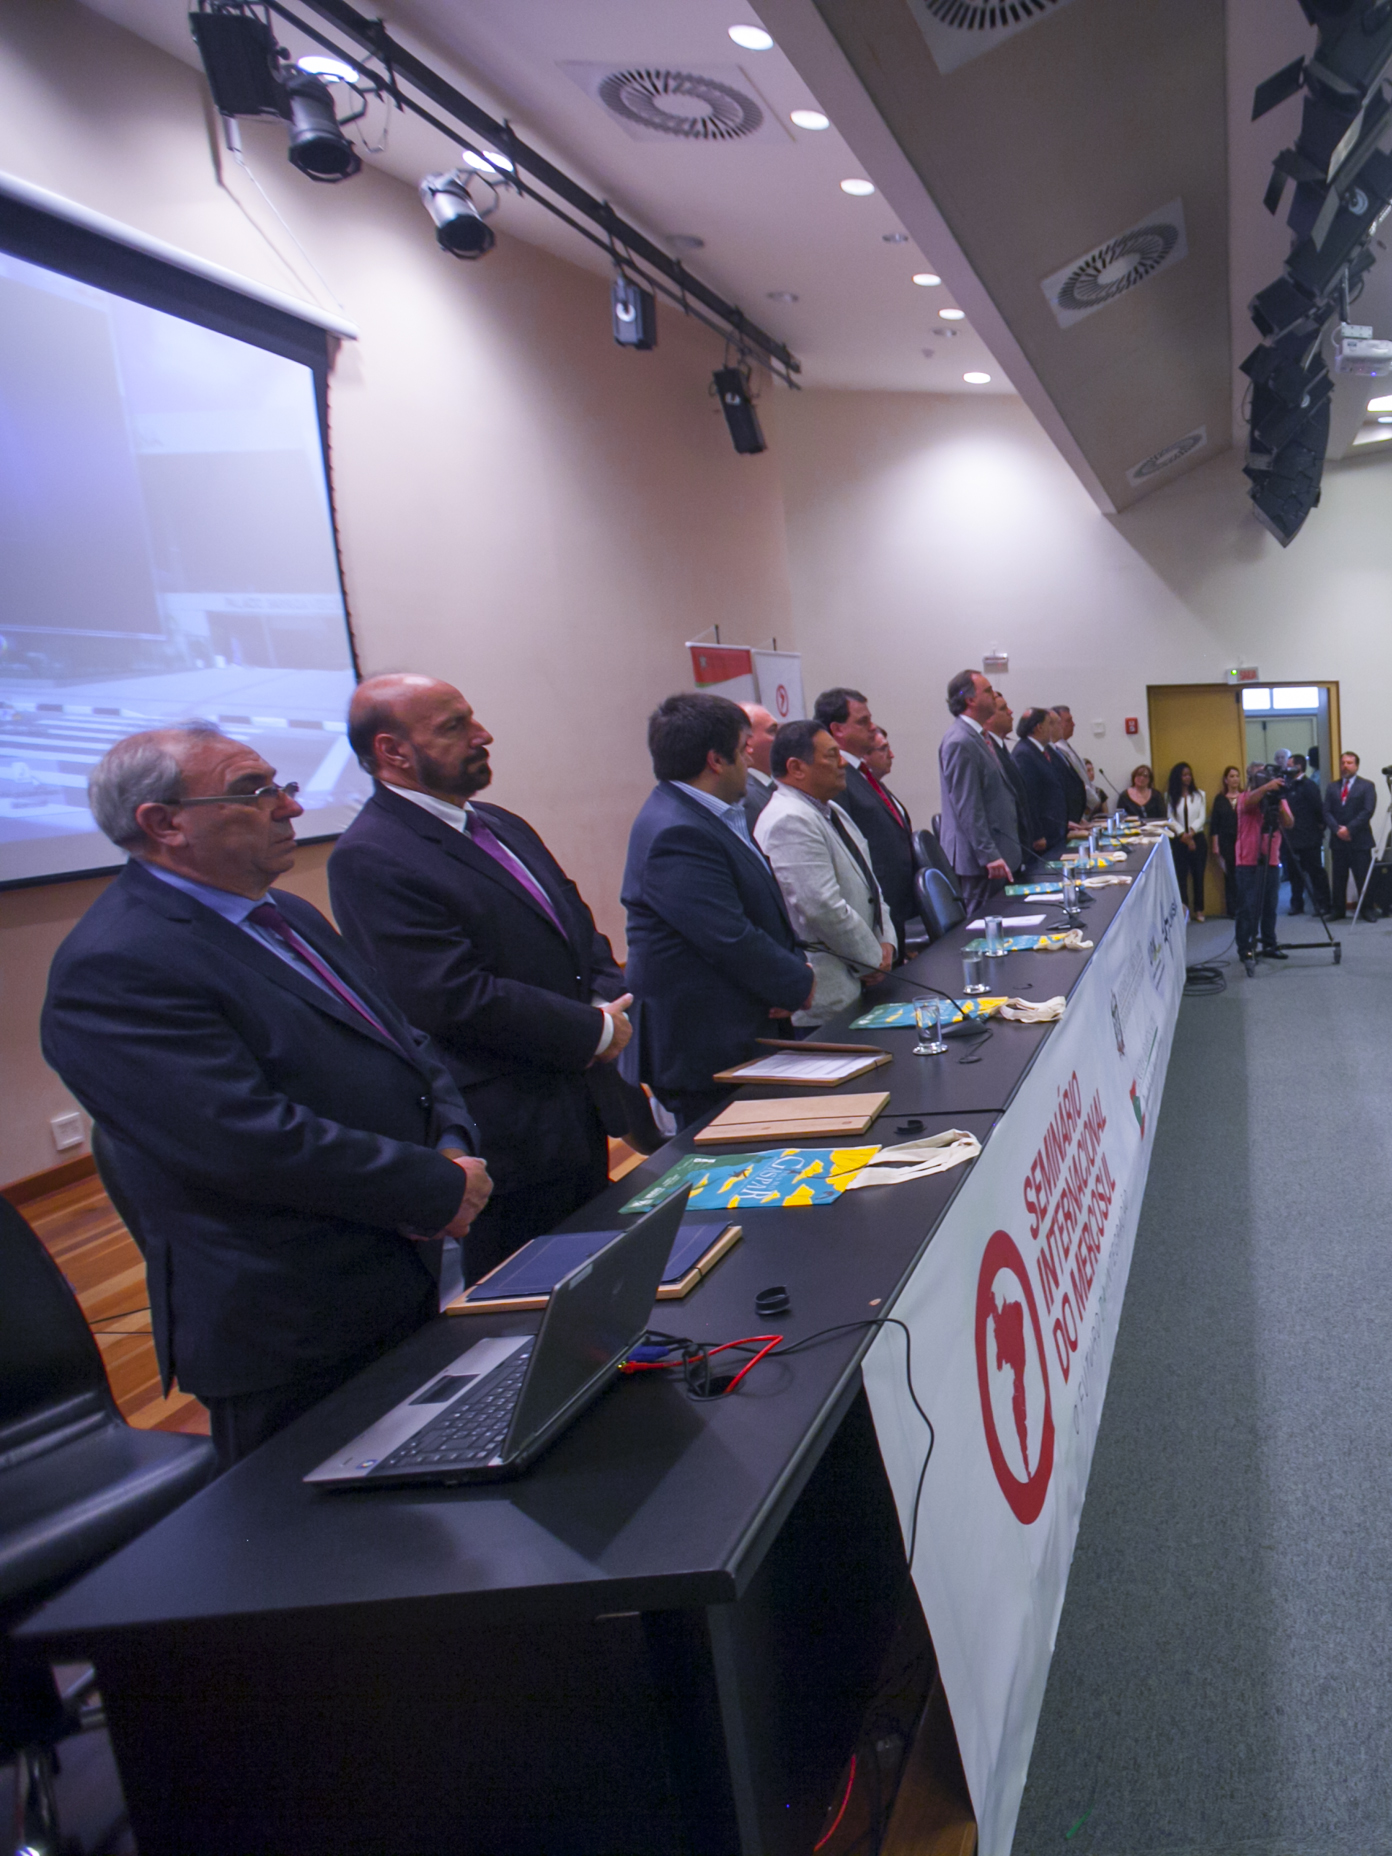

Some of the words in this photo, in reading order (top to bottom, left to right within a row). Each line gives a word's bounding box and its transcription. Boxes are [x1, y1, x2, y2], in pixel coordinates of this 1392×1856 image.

[1023, 1070, 1082, 1240] SEMINÁRIO
[1037, 1088, 1106, 1316] INTERNACIONAL
[1053, 1291, 1078, 1385] DO
[1070, 1151, 1116, 1322] MERCOSUL
